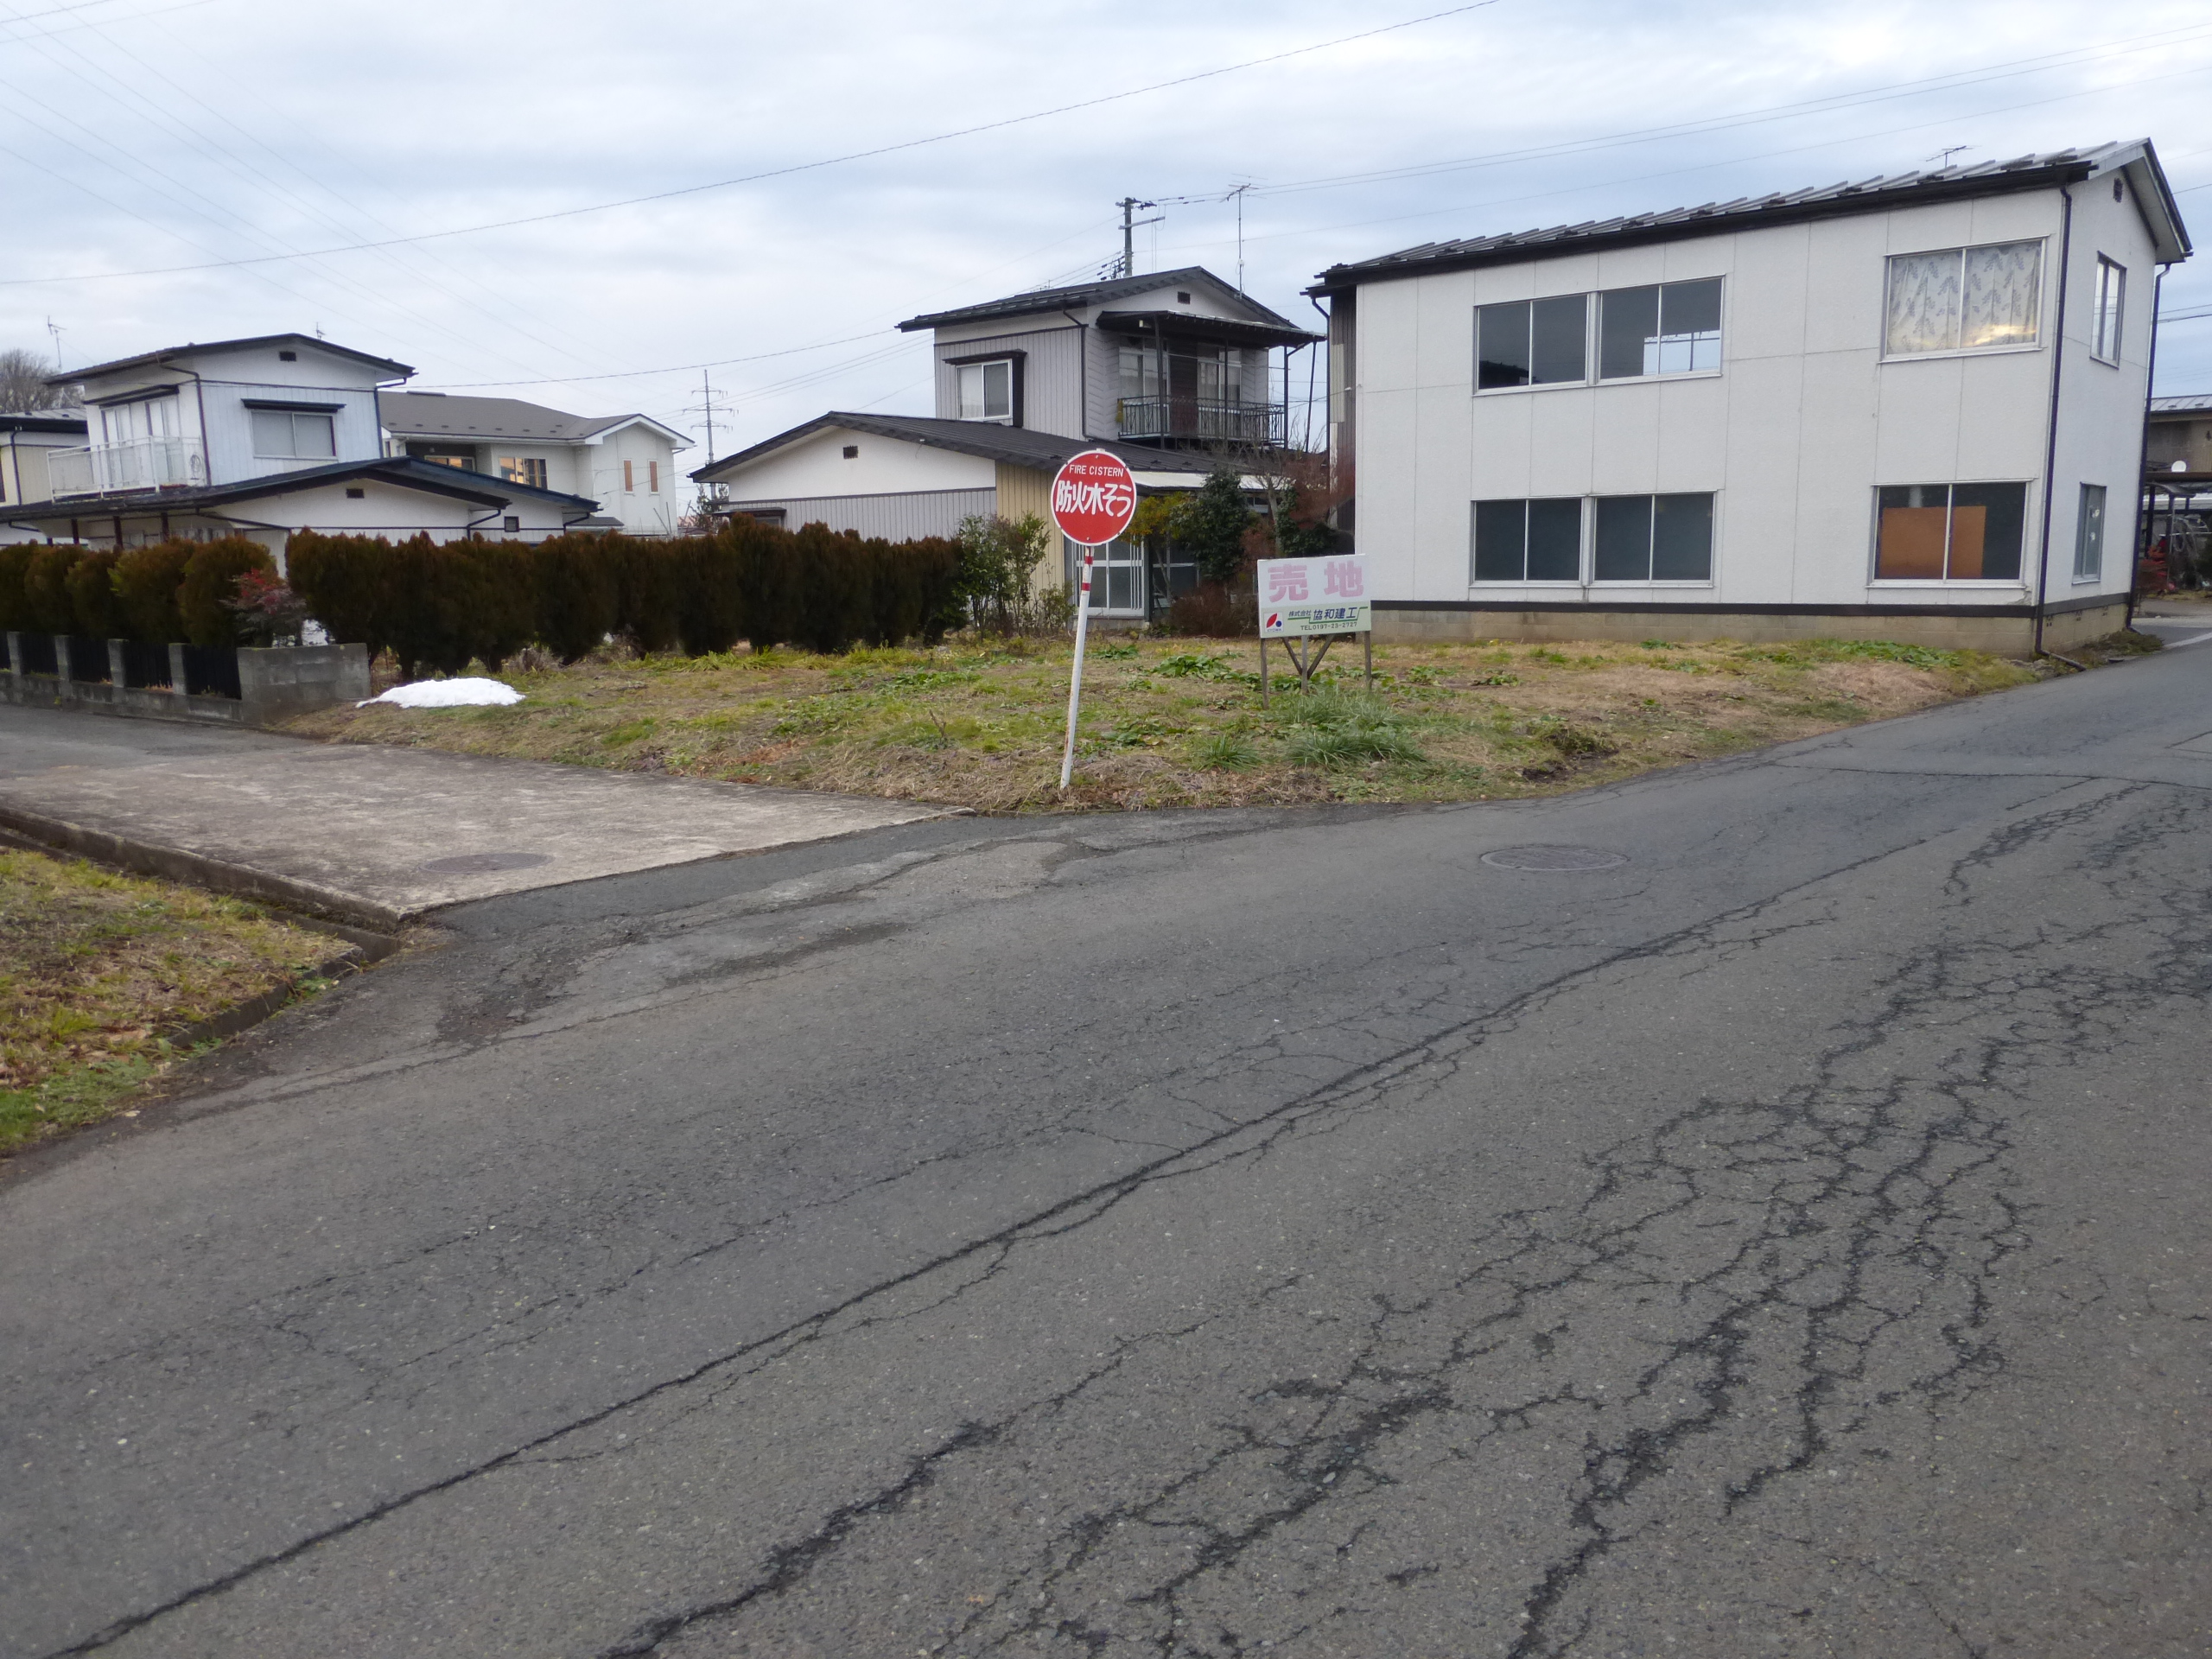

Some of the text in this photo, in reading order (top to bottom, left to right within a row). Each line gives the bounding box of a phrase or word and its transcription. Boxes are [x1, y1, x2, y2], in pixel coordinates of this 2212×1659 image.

[1069, 465, 1124, 477] FIRE CISTERN
[1055, 480, 1132, 518] 防火水そう
[1268, 560, 1364, 603] 売地
